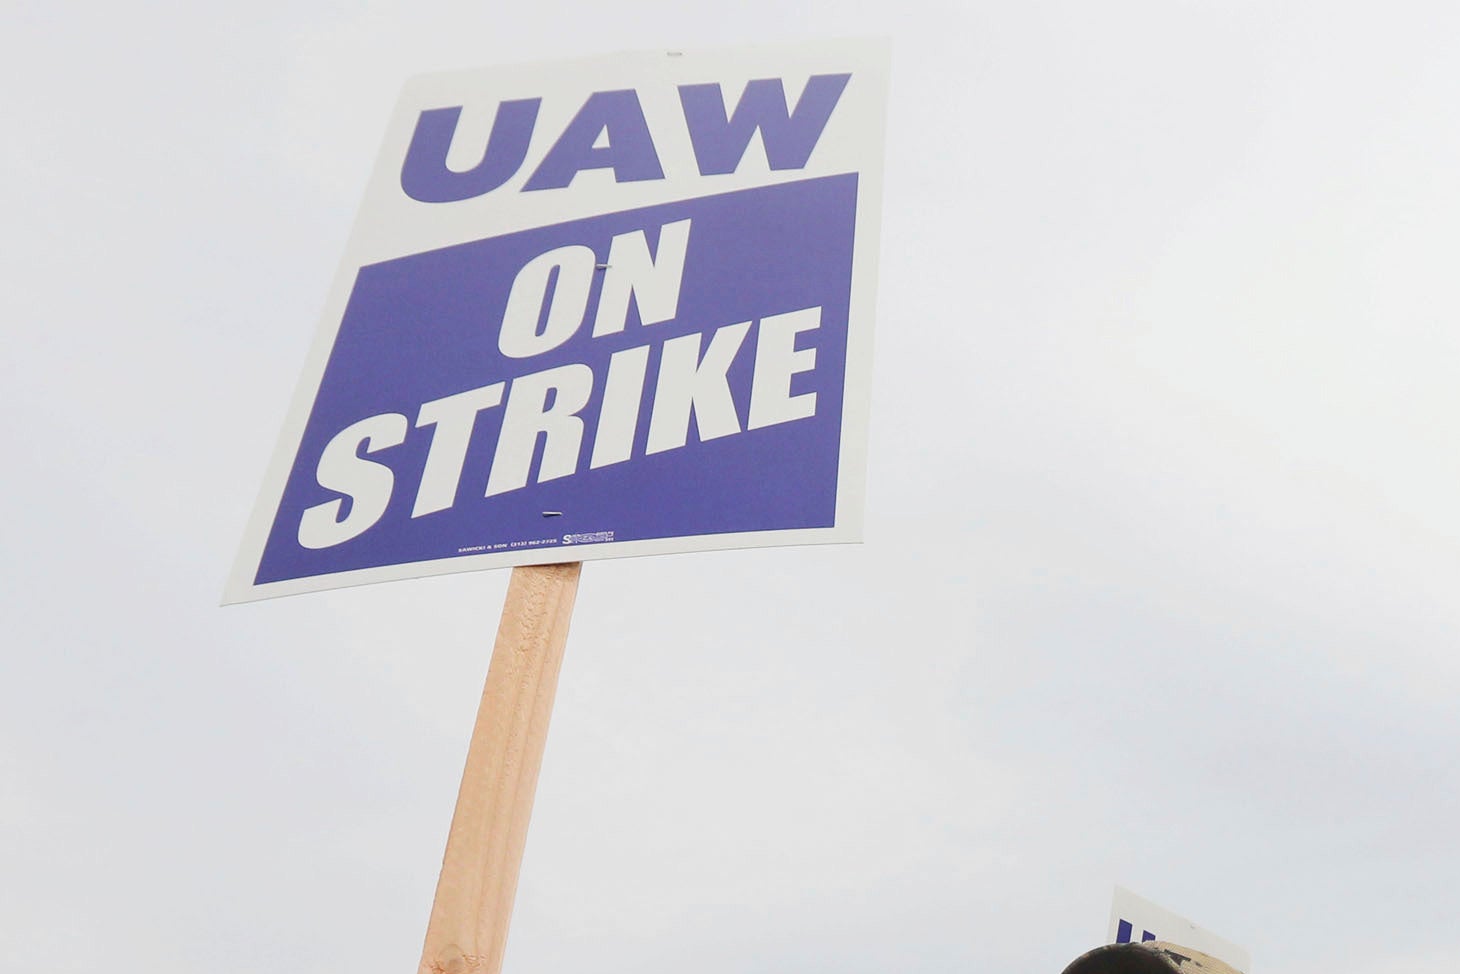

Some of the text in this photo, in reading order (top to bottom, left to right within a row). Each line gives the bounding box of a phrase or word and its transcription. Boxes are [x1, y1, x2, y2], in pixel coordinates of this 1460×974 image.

[400, 73, 852, 203] UAW
[498, 218, 692, 359] ON
[297, 306, 822, 550] STRIKE
